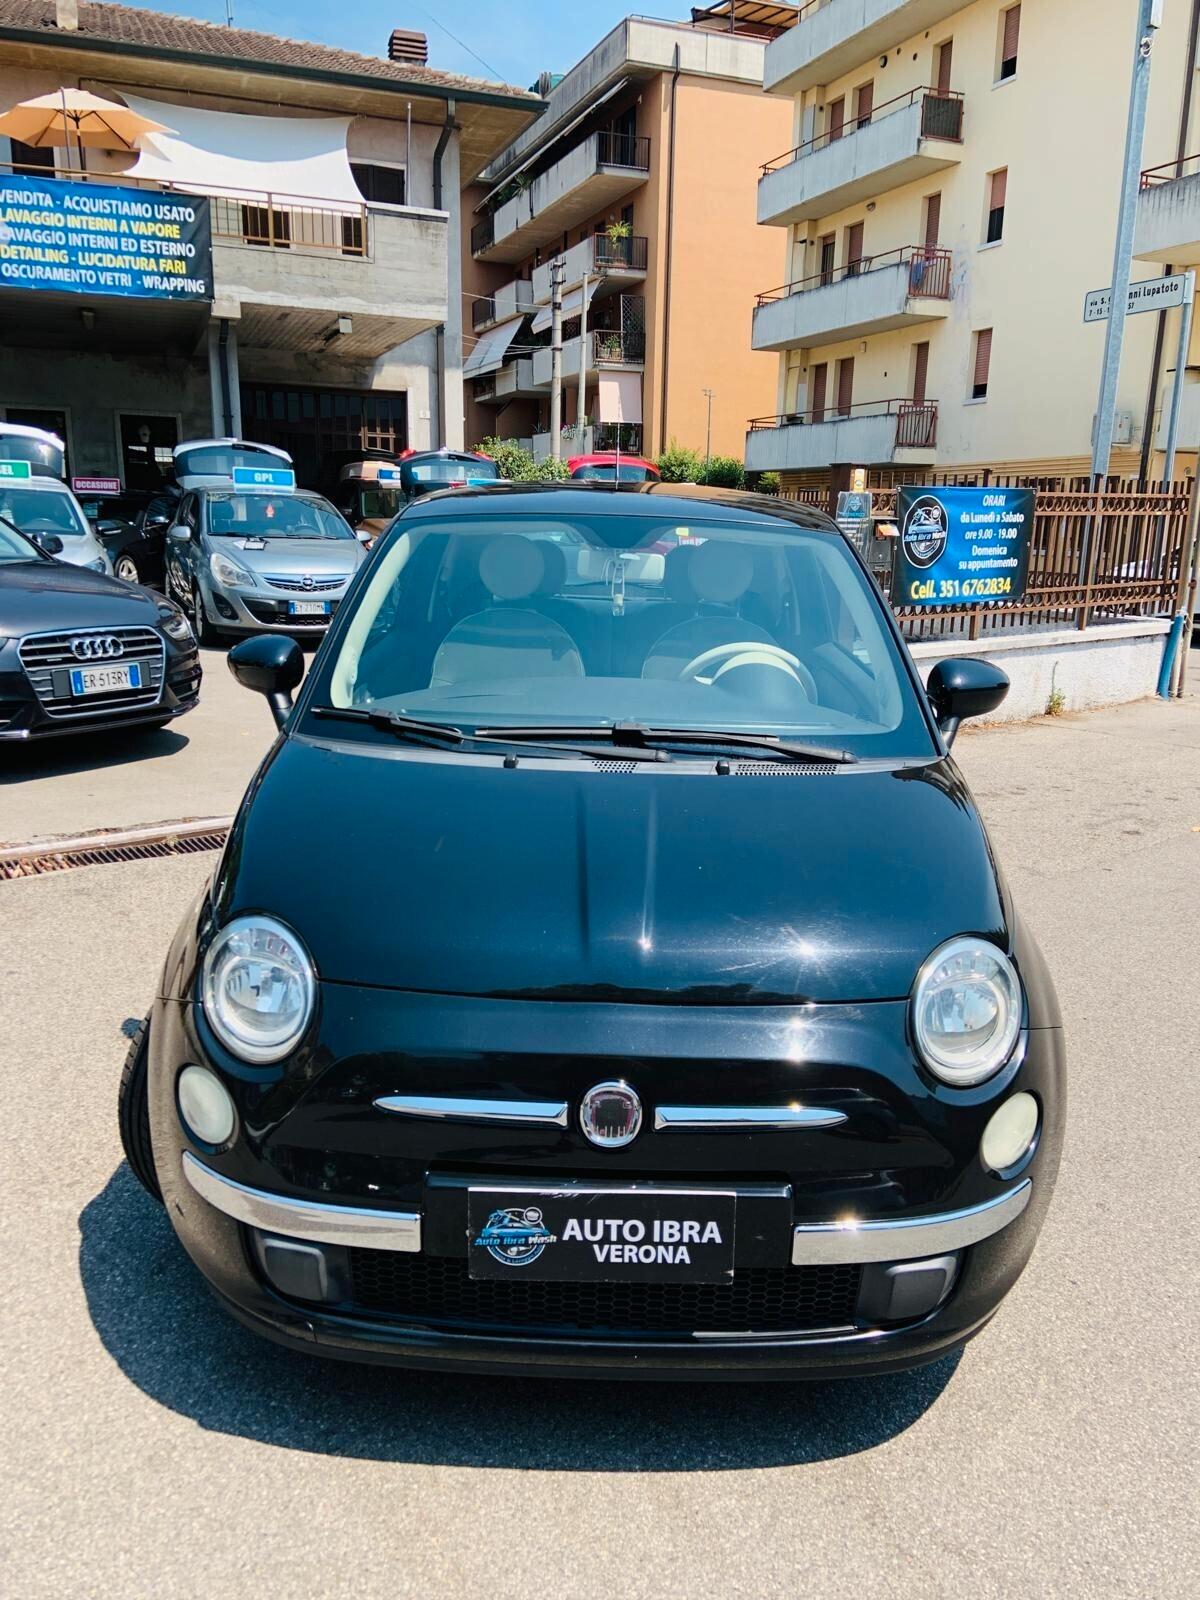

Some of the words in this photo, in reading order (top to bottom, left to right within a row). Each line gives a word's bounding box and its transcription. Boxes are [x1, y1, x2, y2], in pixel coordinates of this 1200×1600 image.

[63, 195, 152, 218] ACQUISTIAMO
[154, 204, 195, 222] USATO
[66, 214, 117, 232] INTERNI
[120, 219, 129, 234] A
[130, 220, 181, 239] VAPORE
[68, 232, 118, 251] INTERNI
[121, 237, 138, 253] ED
[140, 239, 196, 258] ESTERNO
[0, 244, 69, 264] DETAILING
[78, 251, 157, 272] LUCIDATURA
[160, 258, 187, 275] FARI
[1, 262, 97, 285] OSCURAMENTO
[97, 270, 132, 287] VETRI
[142, 275, 206, 294] WRAPPING
[76, 480, 117, 490] OCCASIONE
[254, 472, 274, 483] GPL
[982, 494, 1006, 507] ORARI
[960, 512, 970, 523] da
[1001, 511, 1024, 523] Sabato
[964, 530, 977, 540] ore
[978, 528, 993, 540] 9.00
[998, 528, 1018, 540] 19.00
[972, 544, 1007, 556] Domenica
[958, 561, 967, 570] su
[968, 557, 1018, 572] appuntamento
[911, 579, 936, 599] Cell.
[939, 579, 960, 598] 351
[962, 577, 1012, 597] 6762834
[562, 1218, 646, 1243] AUTO
[653, 1220, 723, 1244] IBRA
[593, 1244, 691, 1265] VERONA
